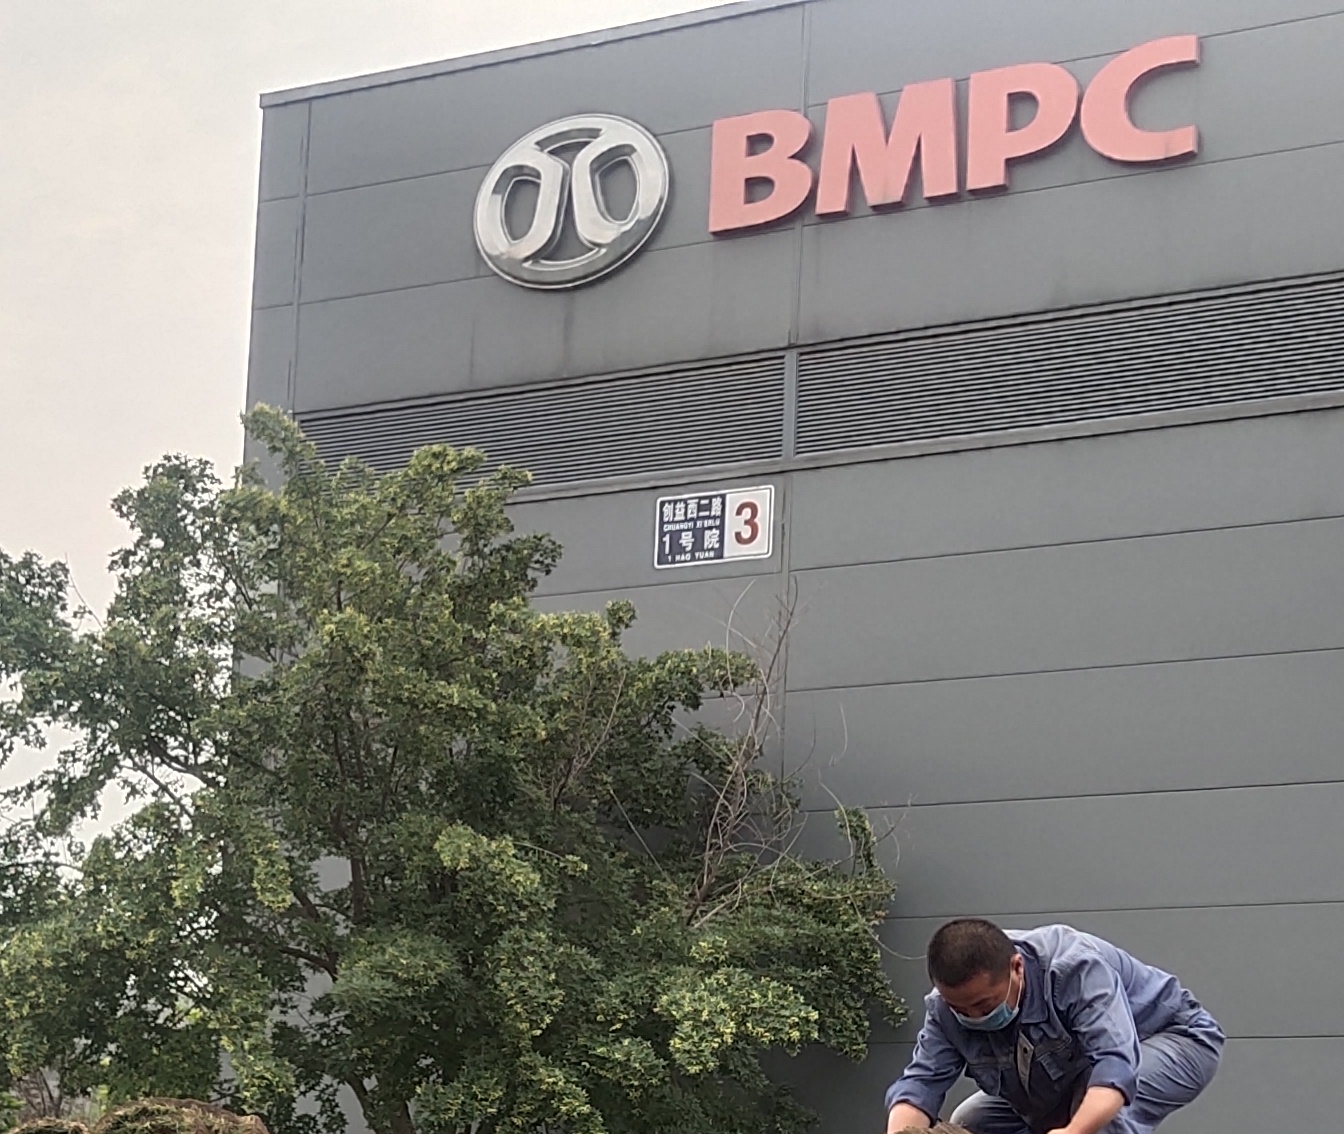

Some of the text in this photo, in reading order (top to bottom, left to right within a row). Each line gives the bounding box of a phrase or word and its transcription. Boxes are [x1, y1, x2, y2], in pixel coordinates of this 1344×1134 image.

[709, 35, 1201, 234] BMPC
[662, 497, 723, 522] 创益西二路
[735, 501, 759, 545] 3
[675, 553, 691, 562] HAO
[695, 550, 715, 560] YUAN
